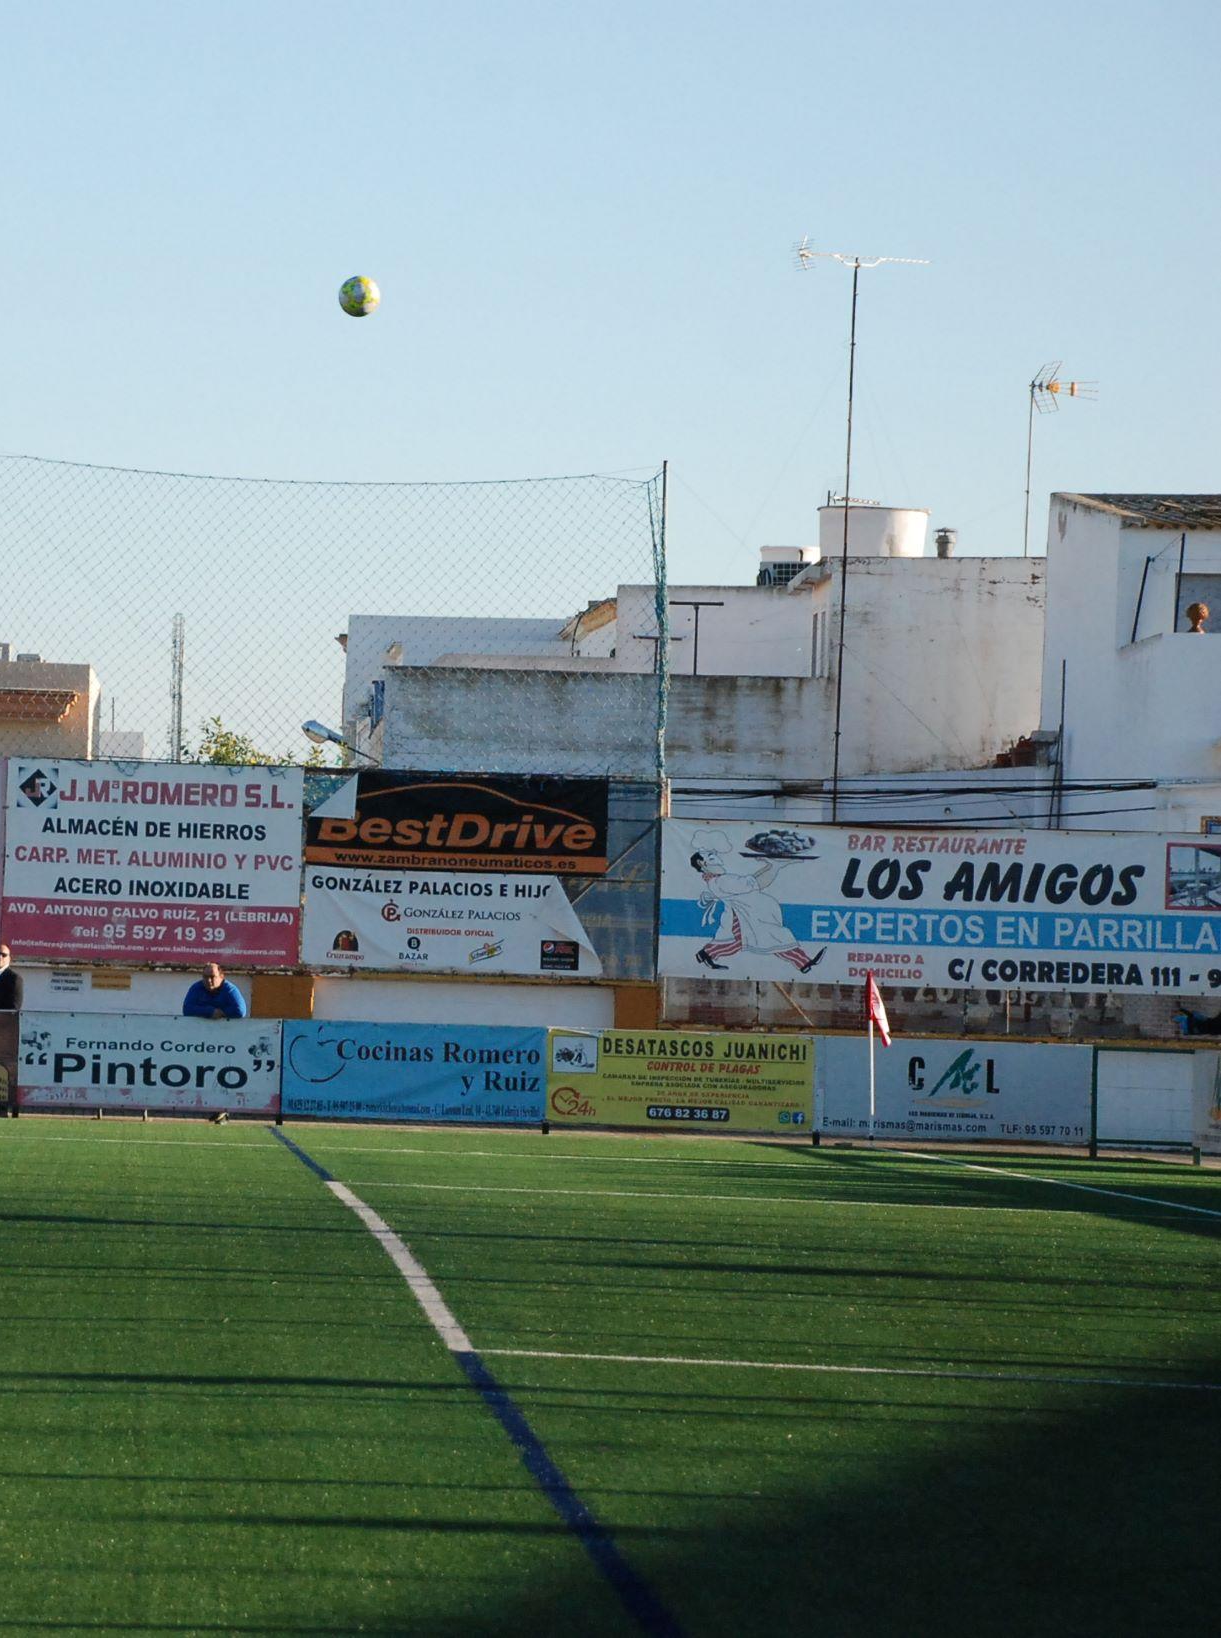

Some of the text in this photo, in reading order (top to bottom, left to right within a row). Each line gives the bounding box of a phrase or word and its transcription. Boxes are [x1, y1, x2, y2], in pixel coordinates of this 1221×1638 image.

[244, 784, 294, 809] S.L.
[42, 816, 266, 841] ALMACÉN DE HIERROS
[317, 812, 597, 850] BestDrive
[848, 834, 1027, 856] BAR RESTAURANTE
[15, 845, 293, 871] CARP. MET. ALUMINIO Y PVC
[335, 852, 577, 870] www.zambranoneumaticos.es
[54, 877, 250, 900] ACERO INOXIDABLE
[311, 874, 402, 895] GONZÁLEZ
[409, 881, 493, 897] PALACIOS
[500, 884, 508, 897] E
[841, 857, 1145, 906] LOS AMIGOS
[8, 902, 40, 914] AVD.
[44, 904, 108, 917] ANTONIO
[112, 906, 159, 919] CALVO
[204, 910, 220, 921] 21
[225, 911, 294, 925] (LEBRIJA)
[403, 906, 521, 921] GONZÁLEZ PALACIOS
[74, 924, 226, 941] Tel: 95 597 19 39
[407, 927, 494, 937] DISTRIBUIDOR OFICIAL
[811, 910, 1218, 951] EXPERTOS EN PARRILLA
[399, 952, 428, 961] BAZAR
[847, 952, 924, 965] REPARTO A
[848, 967, 923, 980] DOMICILIO
[948, 958, 975, 983] C/
[981, 959, 1144, 986] CORREDERA
[1151, 966, 1181, 987] 111
[66, 1037, 236, 1054] Fernando Cordero
[337, 1039, 541, 1065] Cocinas Romero
[603, 1037, 807, 1061] DESATASCOS JUANICHI
[647, 1061, 761, 1075] CONTROL DE PLAGAS
[461, 1070, 540, 1096] y Ruiz
[566, 1101, 596, 1117] 24h
[649, 1106, 728, 1120] 676 82 36 87
[822, 1117, 857, 1129] E-mail:
[1000, 1124, 1022, 1135] TLF:
[1024, 1124, 1036, 1135] 95
[1038, 1124, 1056, 1136] 597
[1059, 1125, 1071, 1136] 70
[1073, 1125, 1084, 1137] 11
